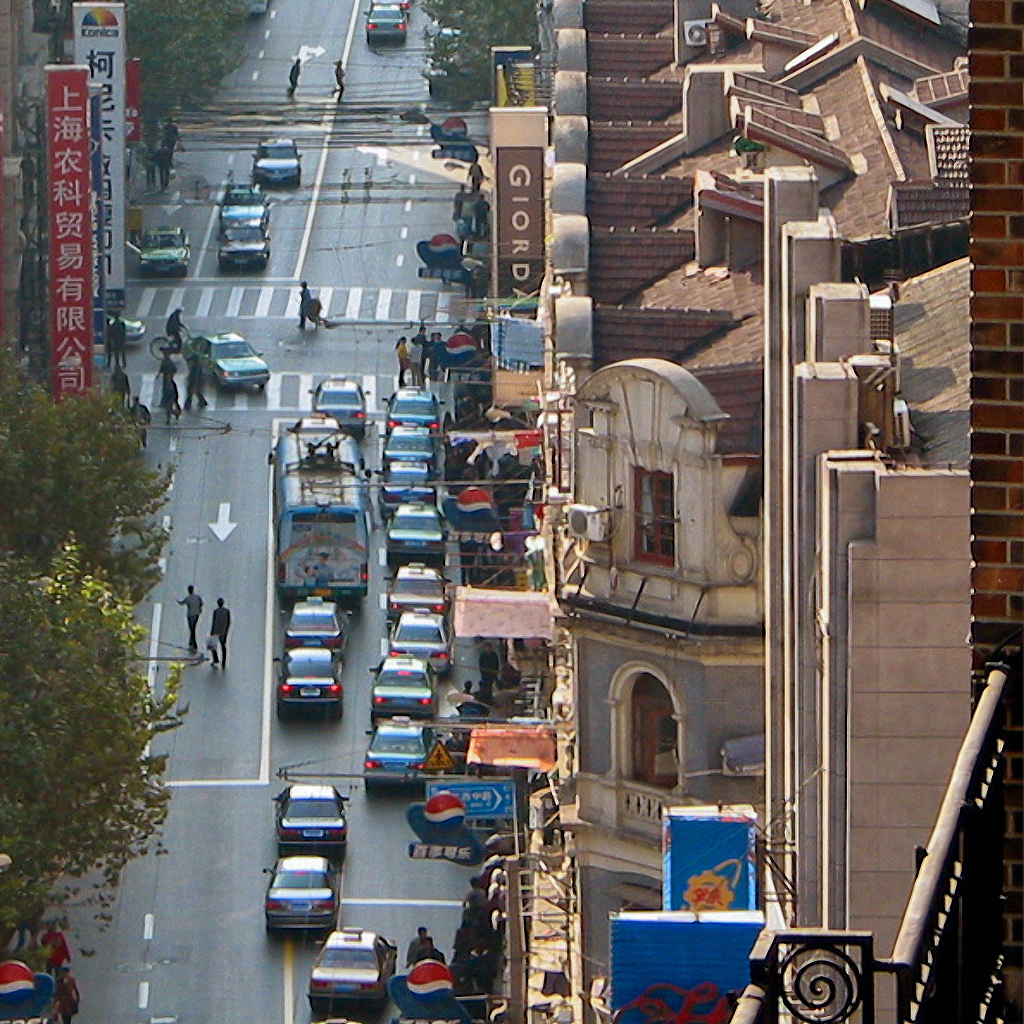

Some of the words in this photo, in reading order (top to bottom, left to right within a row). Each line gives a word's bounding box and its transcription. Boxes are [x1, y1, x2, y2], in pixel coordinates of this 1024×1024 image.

[52, 84, 87, 392] 上海农科贸易有限公司
